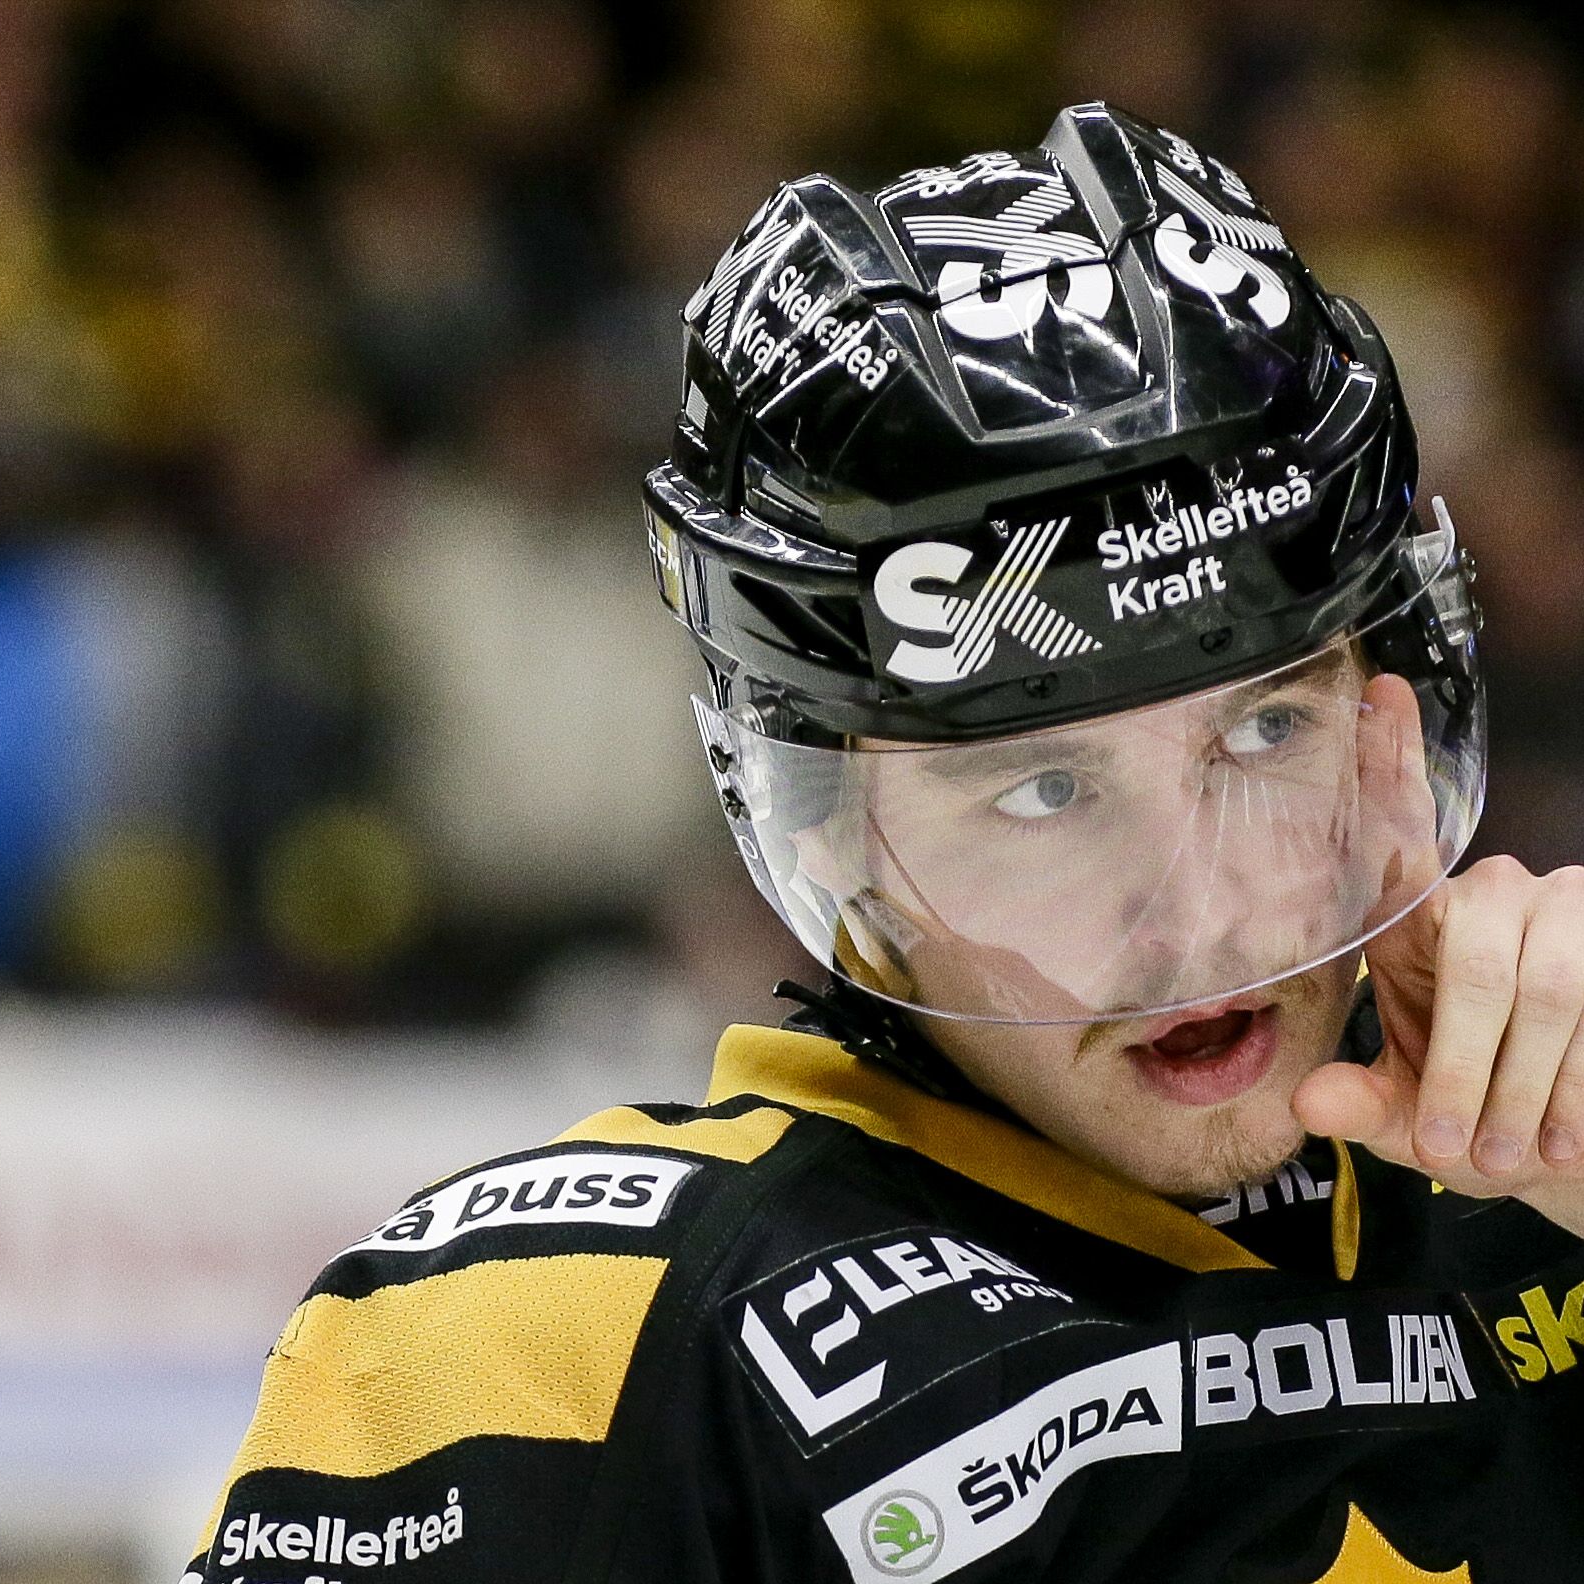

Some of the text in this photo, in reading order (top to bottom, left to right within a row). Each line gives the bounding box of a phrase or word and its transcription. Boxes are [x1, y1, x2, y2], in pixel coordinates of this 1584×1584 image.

[737, 309, 803, 386] Kraft
[768, 265, 899, 391] Skellefteå
[1097, 464, 1312, 570] Skellefteå
[1107, 555, 1227, 622] Kraft
[454, 1173, 659, 1230] buss
[970, 1281, 1074, 1313] group
[1195, 1314, 1477, 1427] BOLIDEN
[957, 1386, 1164, 1525] ŠKODA
[219, 1486, 464, 1568] Skellefteå
